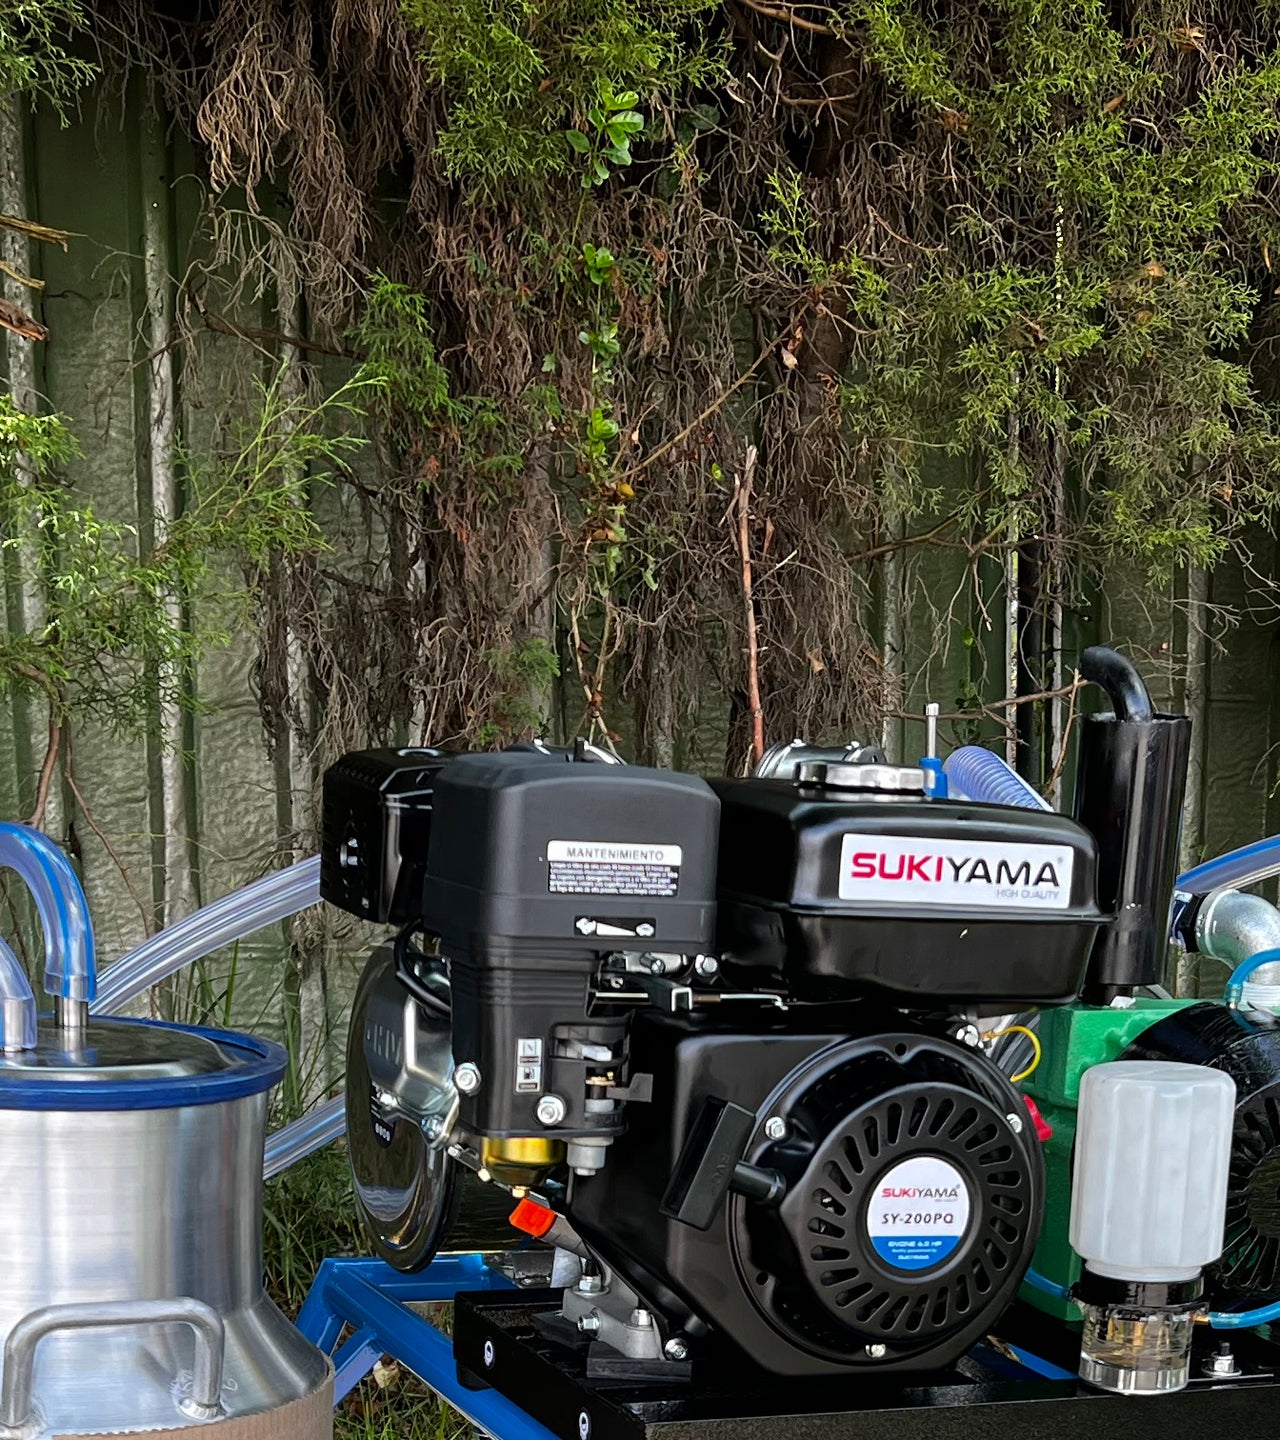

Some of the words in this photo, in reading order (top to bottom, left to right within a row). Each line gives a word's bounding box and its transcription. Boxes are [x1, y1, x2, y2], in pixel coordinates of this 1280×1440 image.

[567, 847, 664, 861] MANTENIMIENTO
[851, 852, 1060, 888] SUKIYAMA
[882, 1187, 959, 1198] SUKIYAMA
[881, 1213, 954, 1224] SY-200PQ
